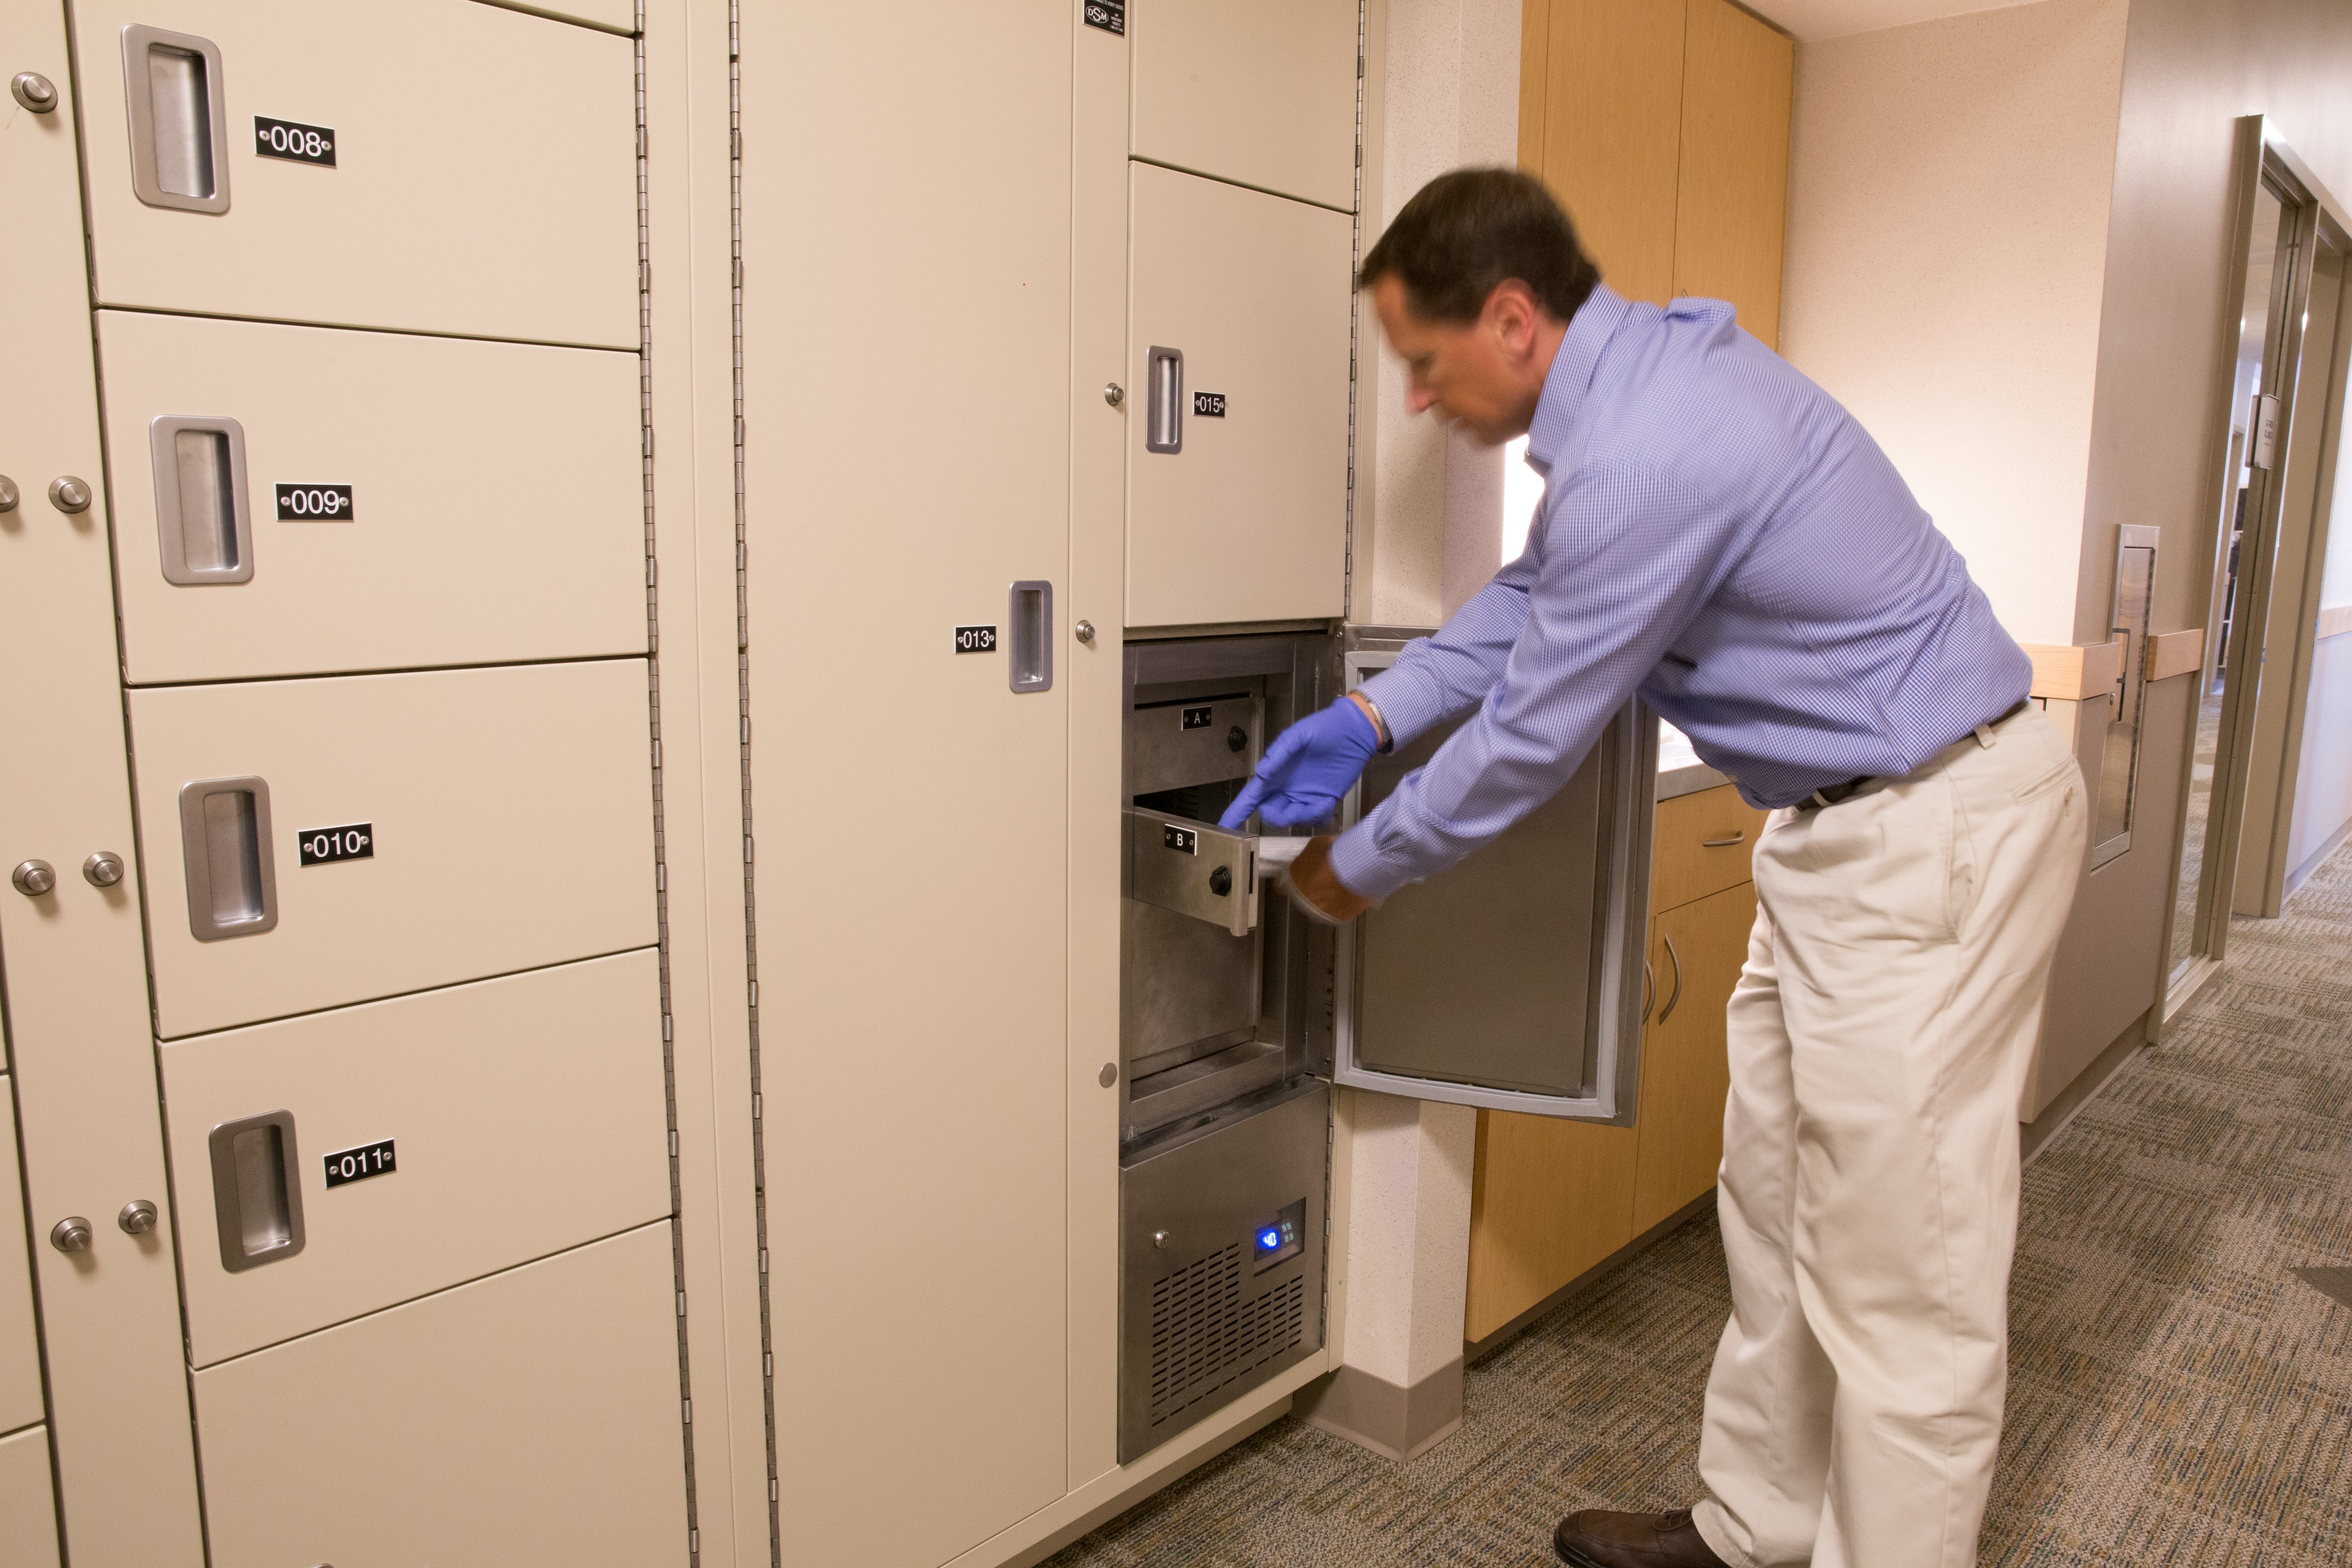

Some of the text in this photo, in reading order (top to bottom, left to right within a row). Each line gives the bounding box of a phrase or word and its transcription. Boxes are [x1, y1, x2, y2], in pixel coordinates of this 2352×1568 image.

[1088, 8, 1107, 21] DSM
[271, 125, 322, 157] 008
[1200, 396, 1220, 413] 015
[291, 490, 340, 514] 009
[963, 630, 989, 649] 013
[1194, 713, 1201, 724] A
[314, 830, 361, 858] 010
[1177, 833, 1183, 846] B
[341, 1148, 382, 1177] 011
[1264, 1232, 1276, 1246] 40
